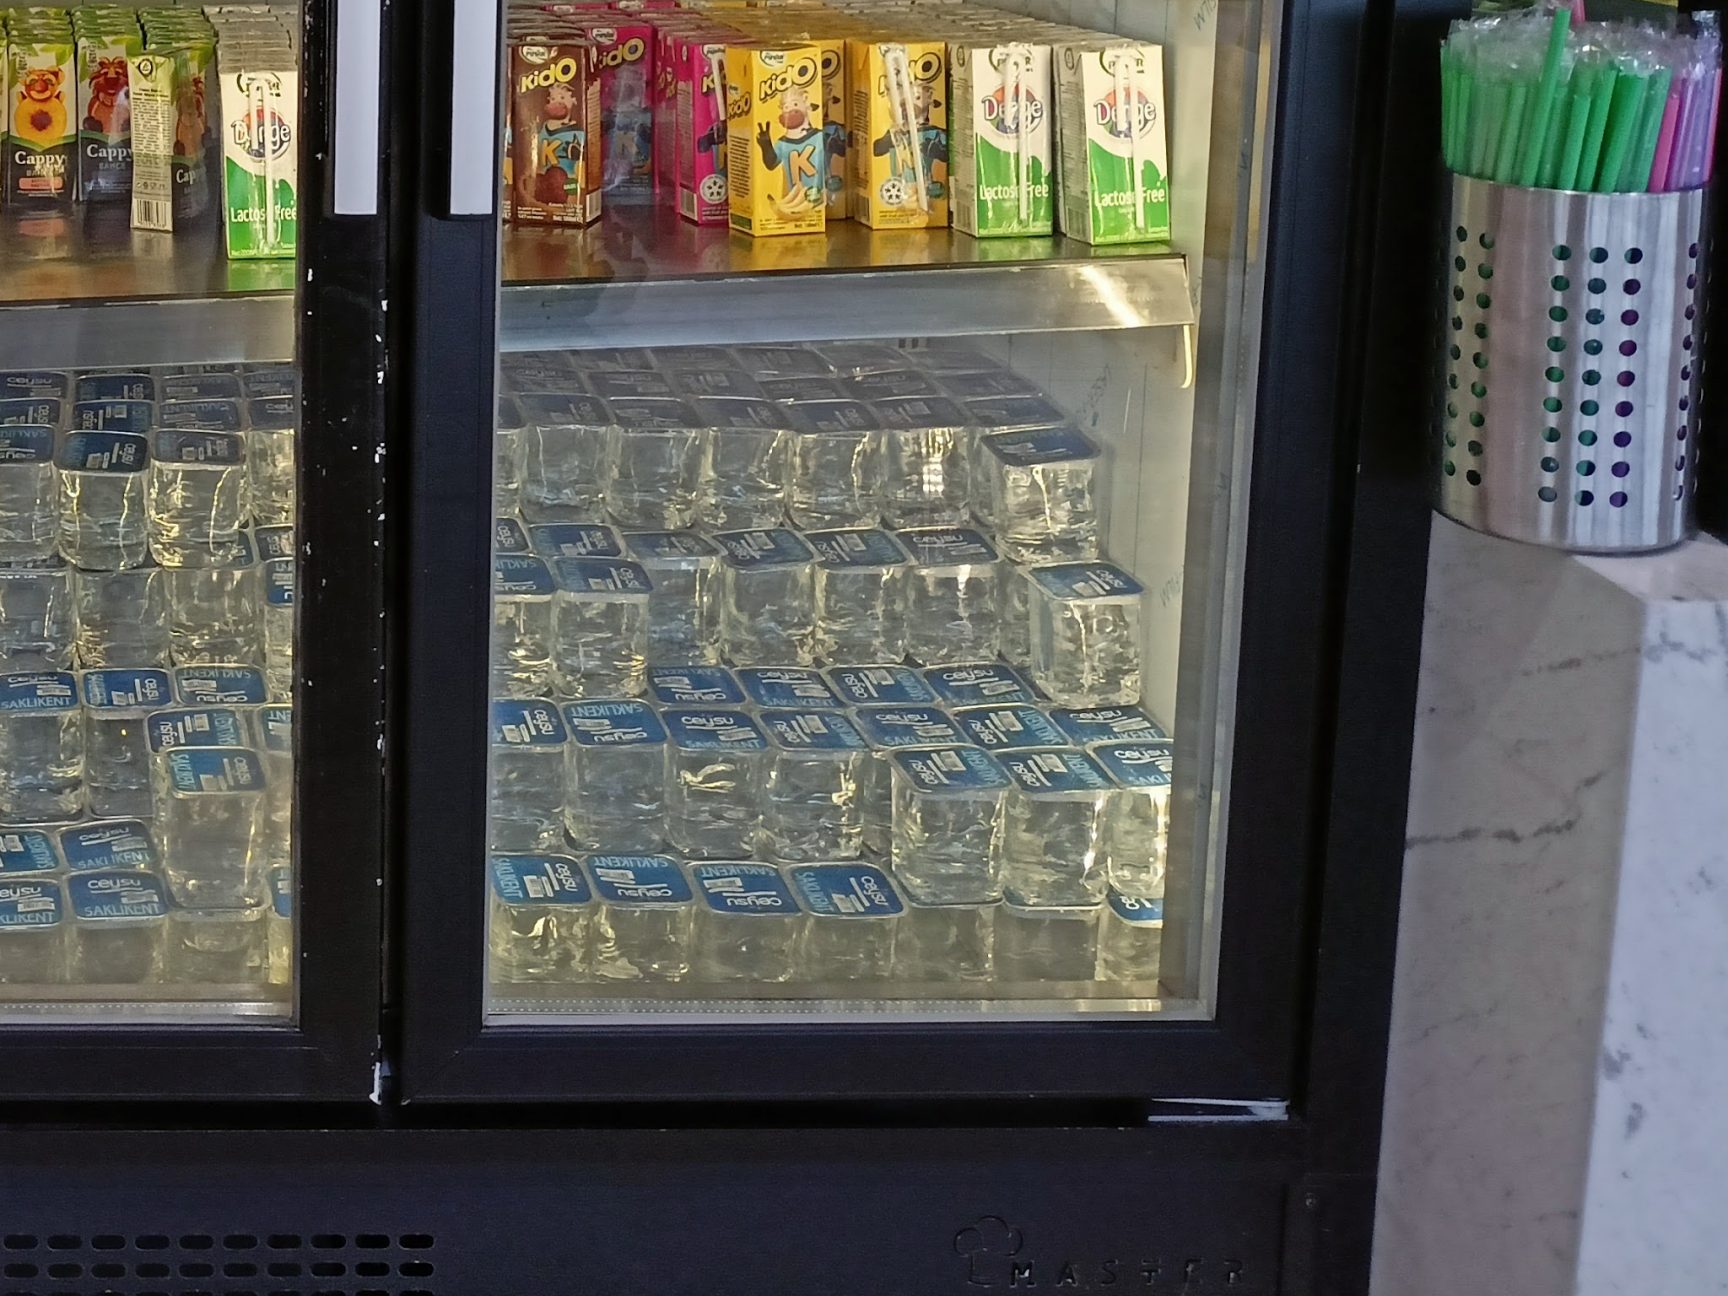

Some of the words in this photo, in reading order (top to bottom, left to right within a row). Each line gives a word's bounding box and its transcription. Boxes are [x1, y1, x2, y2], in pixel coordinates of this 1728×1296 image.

[14, 151, 64, 166] Cappy
[0, 697, 71, 709] SAKLIKENT
[681, 716, 734, 728] ceysu
[87, 878, 142, 889] ceysu
[84, 904, 160, 917] SAKLIKENT
[1010, 1259, 1244, 1287] MASTER
